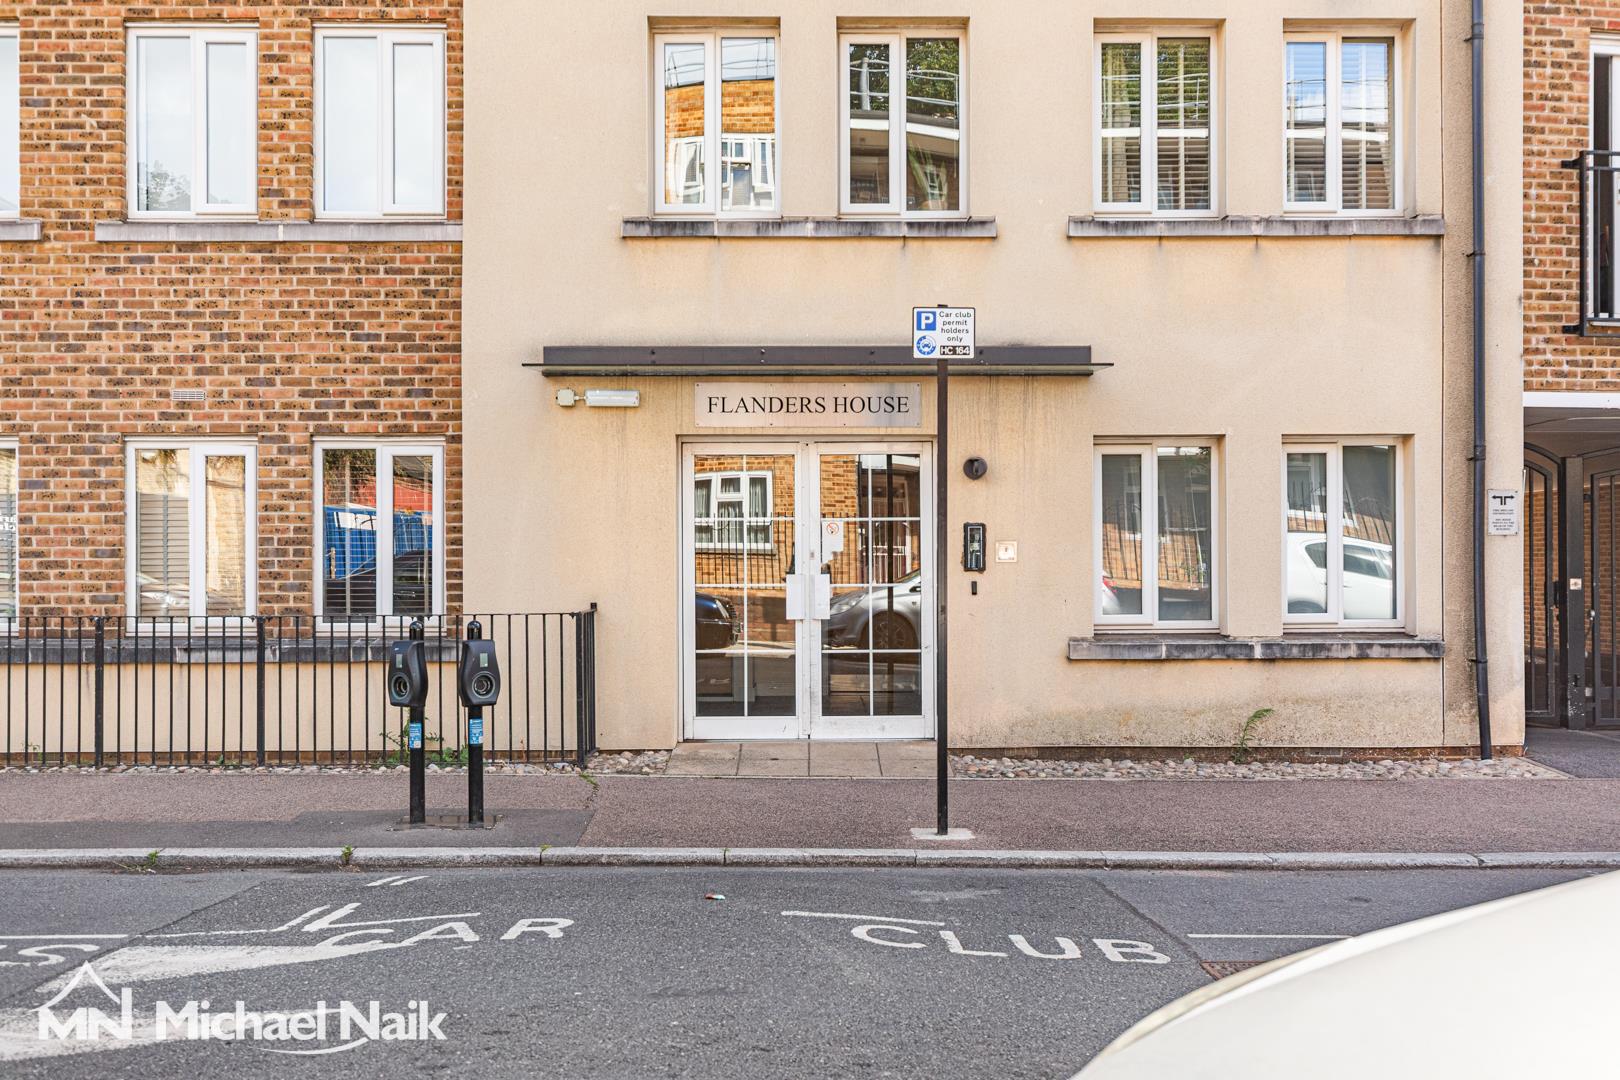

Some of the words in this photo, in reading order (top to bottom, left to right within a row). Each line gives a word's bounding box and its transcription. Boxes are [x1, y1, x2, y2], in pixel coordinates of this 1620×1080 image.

[940, 346, 954, 354] HC
[956, 346, 970, 354] 164
[707, 396, 826, 414] FLANDERS
[832, 396, 910, 414] HOUSE
[314, 917, 575, 948] CAR
[850, 925, 1172, 964] CLUB
